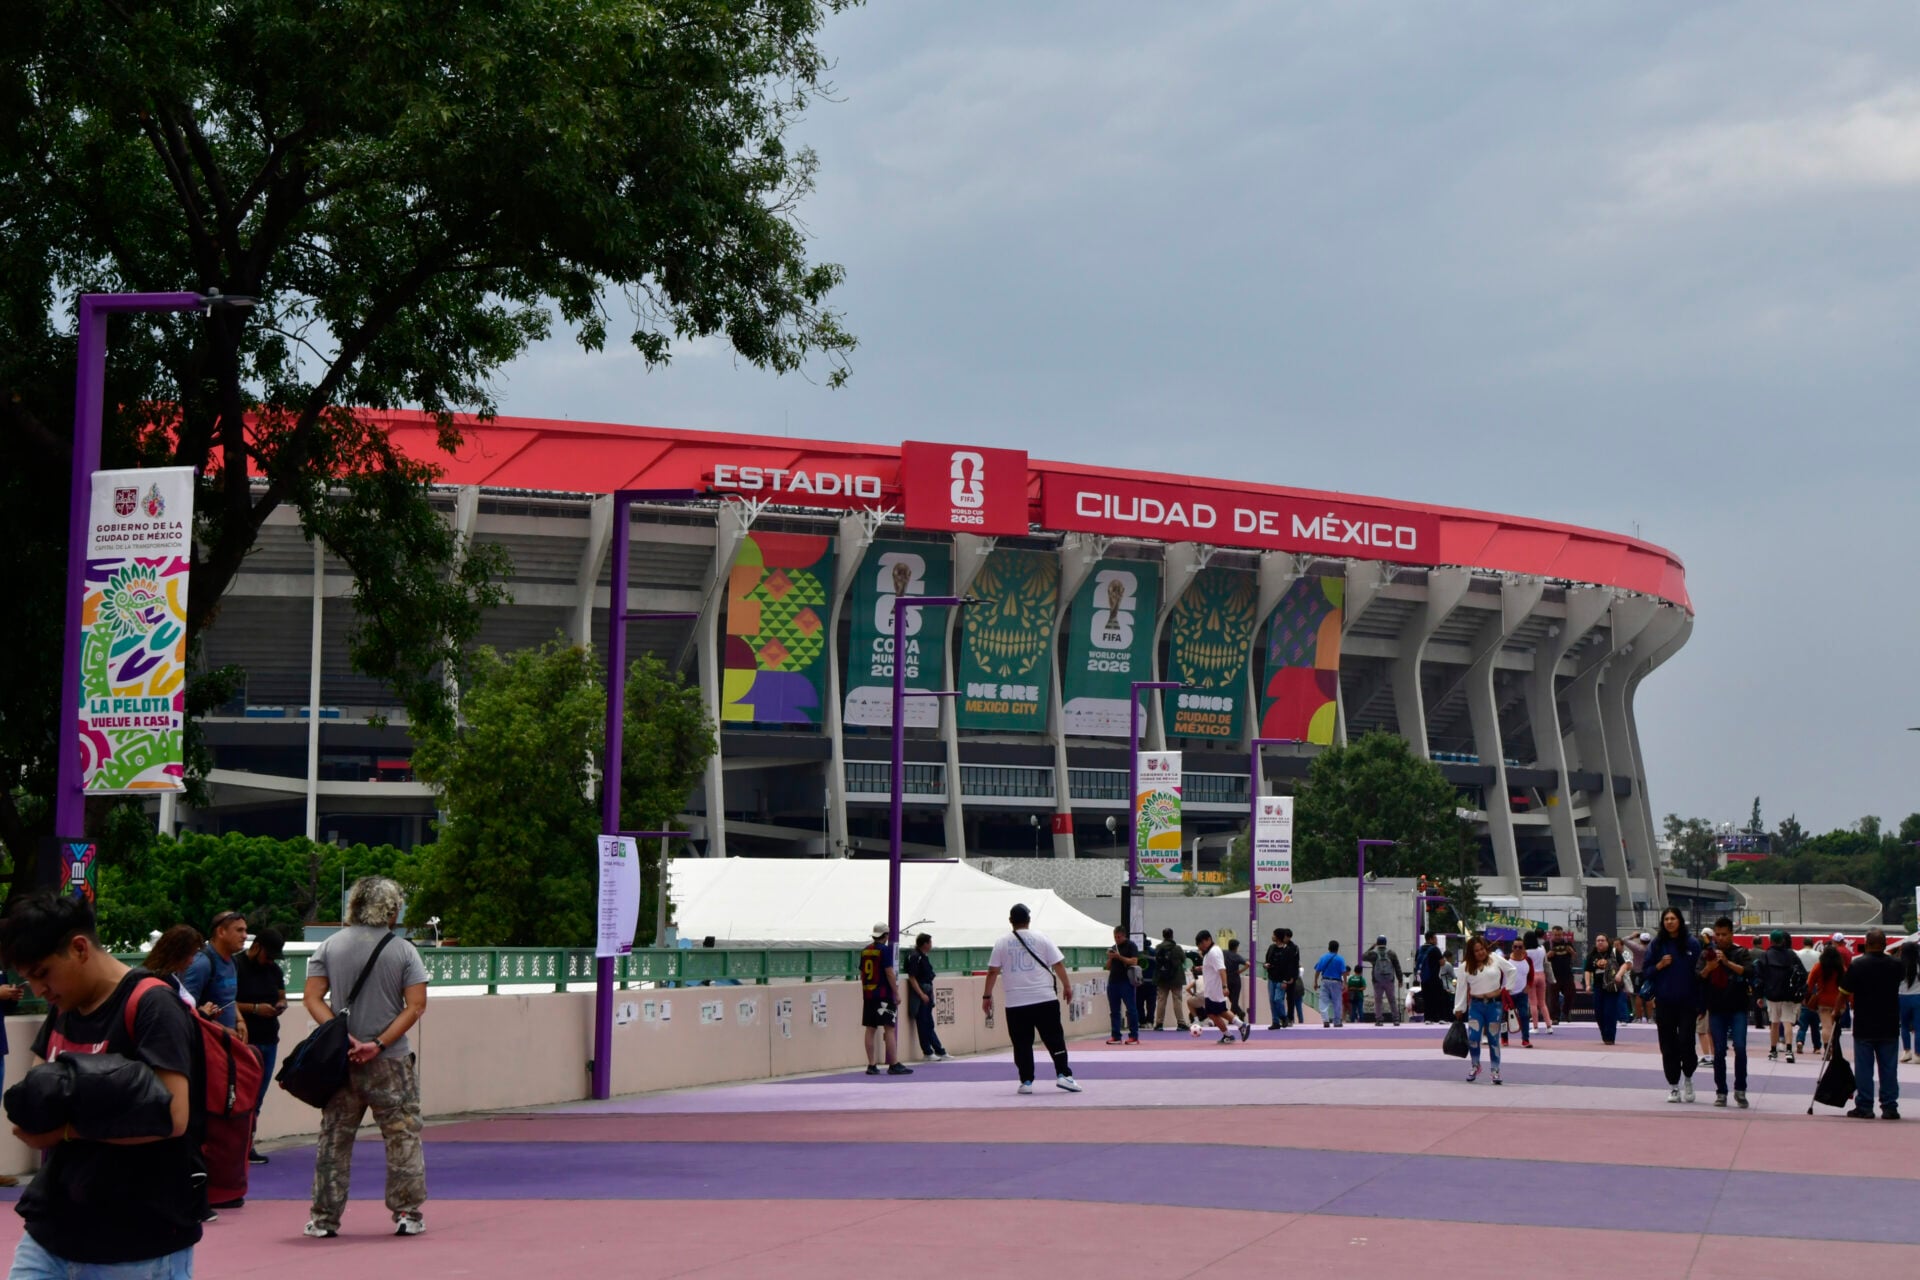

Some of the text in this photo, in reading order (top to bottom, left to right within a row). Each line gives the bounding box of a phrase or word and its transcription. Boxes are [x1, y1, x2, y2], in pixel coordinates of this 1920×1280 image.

[714, 463, 882, 499] ESTADIO
[960, 495, 976, 503] FIFA
[97, 521, 183, 532] GOBIERNO DE LA
[951, 514, 985, 525] 2026
[1075, 491, 1416, 551] CIUDAD DE MÉXICO
[95, 531, 183, 543] CIUDAD DE MÉXICO
[1102, 632, 1122, 643] FIFA
[872, 637, 920, 655] COA
[871, 653, 919, 665] MUNAL
[1088, 650, 1132, 661] WORLD CUP
[870, 664, 920, 678] 206
[1087, 658, 1131, 674] 2026
[966, 682, 1040, 702] WE ARE
[91, 697, 170, 714] LA PELOTA
[965, 700, 1037, 716] MEXICO CITY
[1177, 693, 1234, 712] SOMOS
[91, 715, 170, 728] VUELVE A CASA
[1175, 711, 1232, 725] CIUDAD DE
[1174, 721, 1231, 736] MÉXICO
[1055, 817, 1062, 830] 7
[1007, 949, 1035, 972] 10
[864, 959, 874, 980] 9
